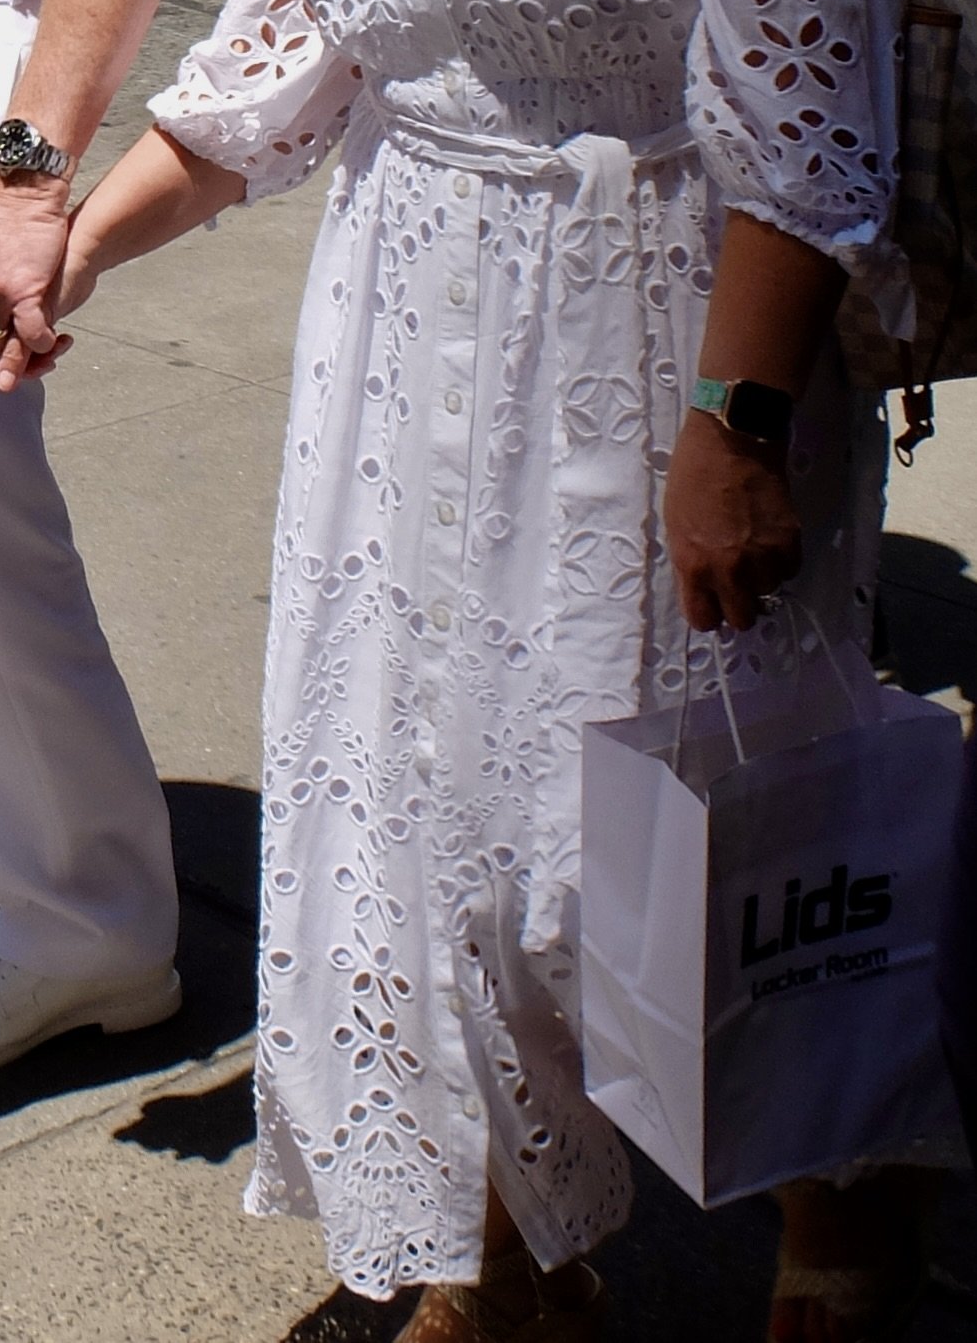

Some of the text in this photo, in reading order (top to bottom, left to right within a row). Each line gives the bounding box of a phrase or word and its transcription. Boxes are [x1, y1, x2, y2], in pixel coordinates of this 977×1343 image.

[740, 864, 893, 969] Lids
[751, 964, 823, 1001] Locker
[826, 947, 889, 978] Room
